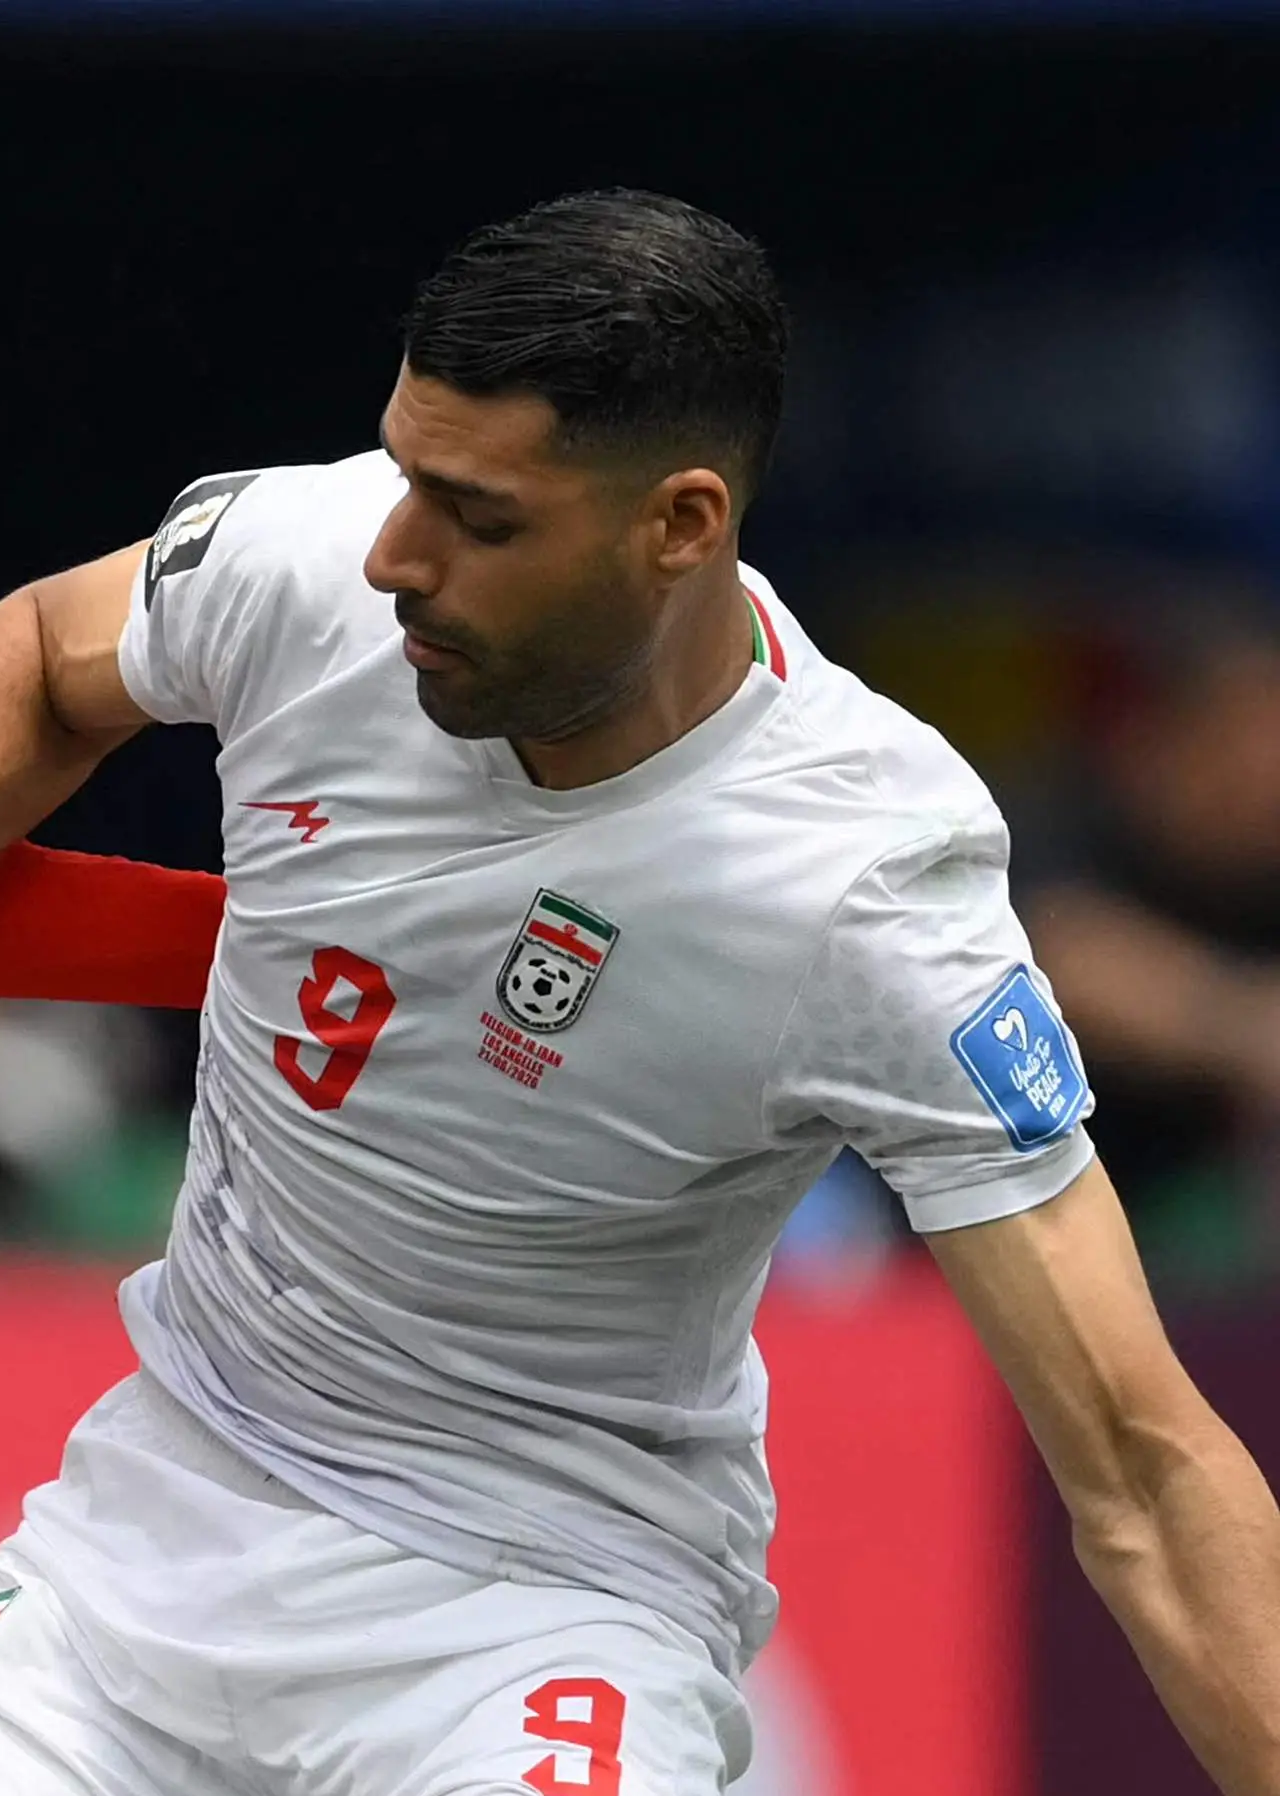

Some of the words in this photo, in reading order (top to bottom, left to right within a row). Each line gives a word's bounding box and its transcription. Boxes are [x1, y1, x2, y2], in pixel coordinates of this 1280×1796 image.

[273, 945, 397, 1111] 9
[483, 1032, 502, 1053] LOS
[501, 1045, 544, 1077] ANGELES
[1026, 1060, 1062, 1112] PEACE
